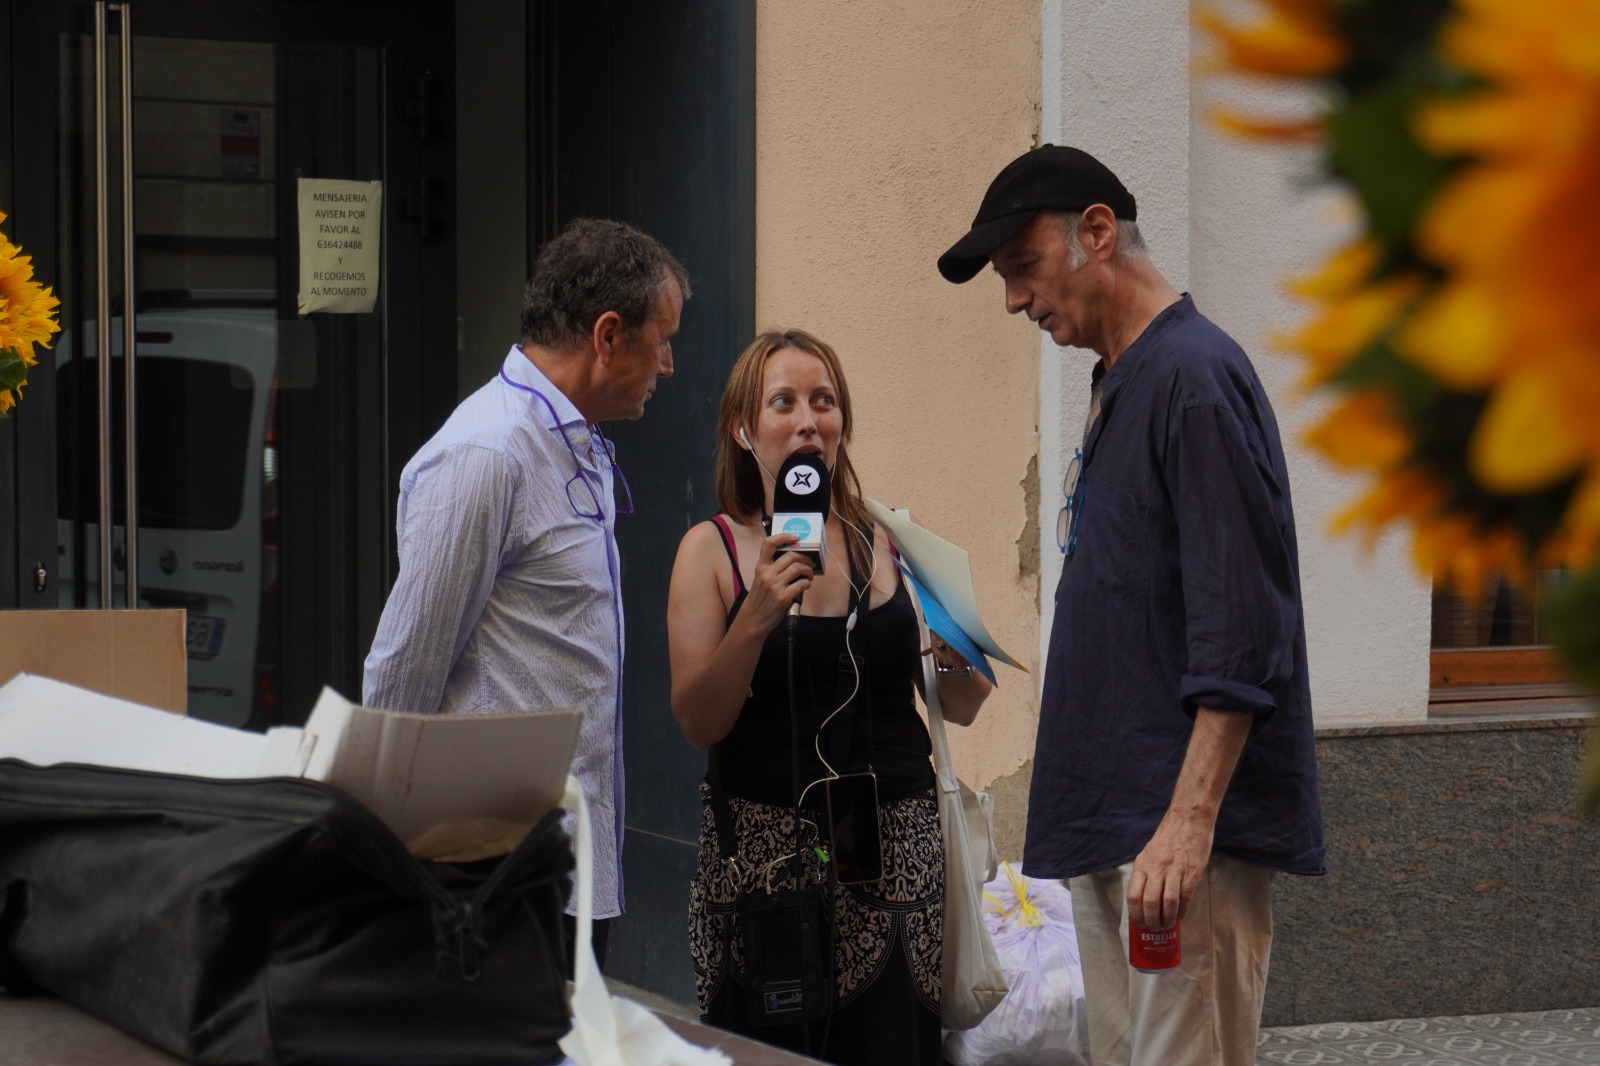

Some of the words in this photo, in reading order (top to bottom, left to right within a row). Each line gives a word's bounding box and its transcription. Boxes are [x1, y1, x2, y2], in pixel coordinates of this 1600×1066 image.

[313, 193, 367, 203] MENSAJERIA
[315, 209, 346, 219] AVISEN
[348, 210, 366, 220] POR
[320, 225, 349, 234] FAVOR
[351, 226, 360, 235] AL
[317, 240, 363, 249] 636424488
[338, 257, 343, 265] Y
[313, 271, 366, 281] RECOGEMOS
[311, 287, 321, 296] AL
[322, 287, 367, 296] MOMENTO
[1141, 931, 1176, 940] ESTRELLA
